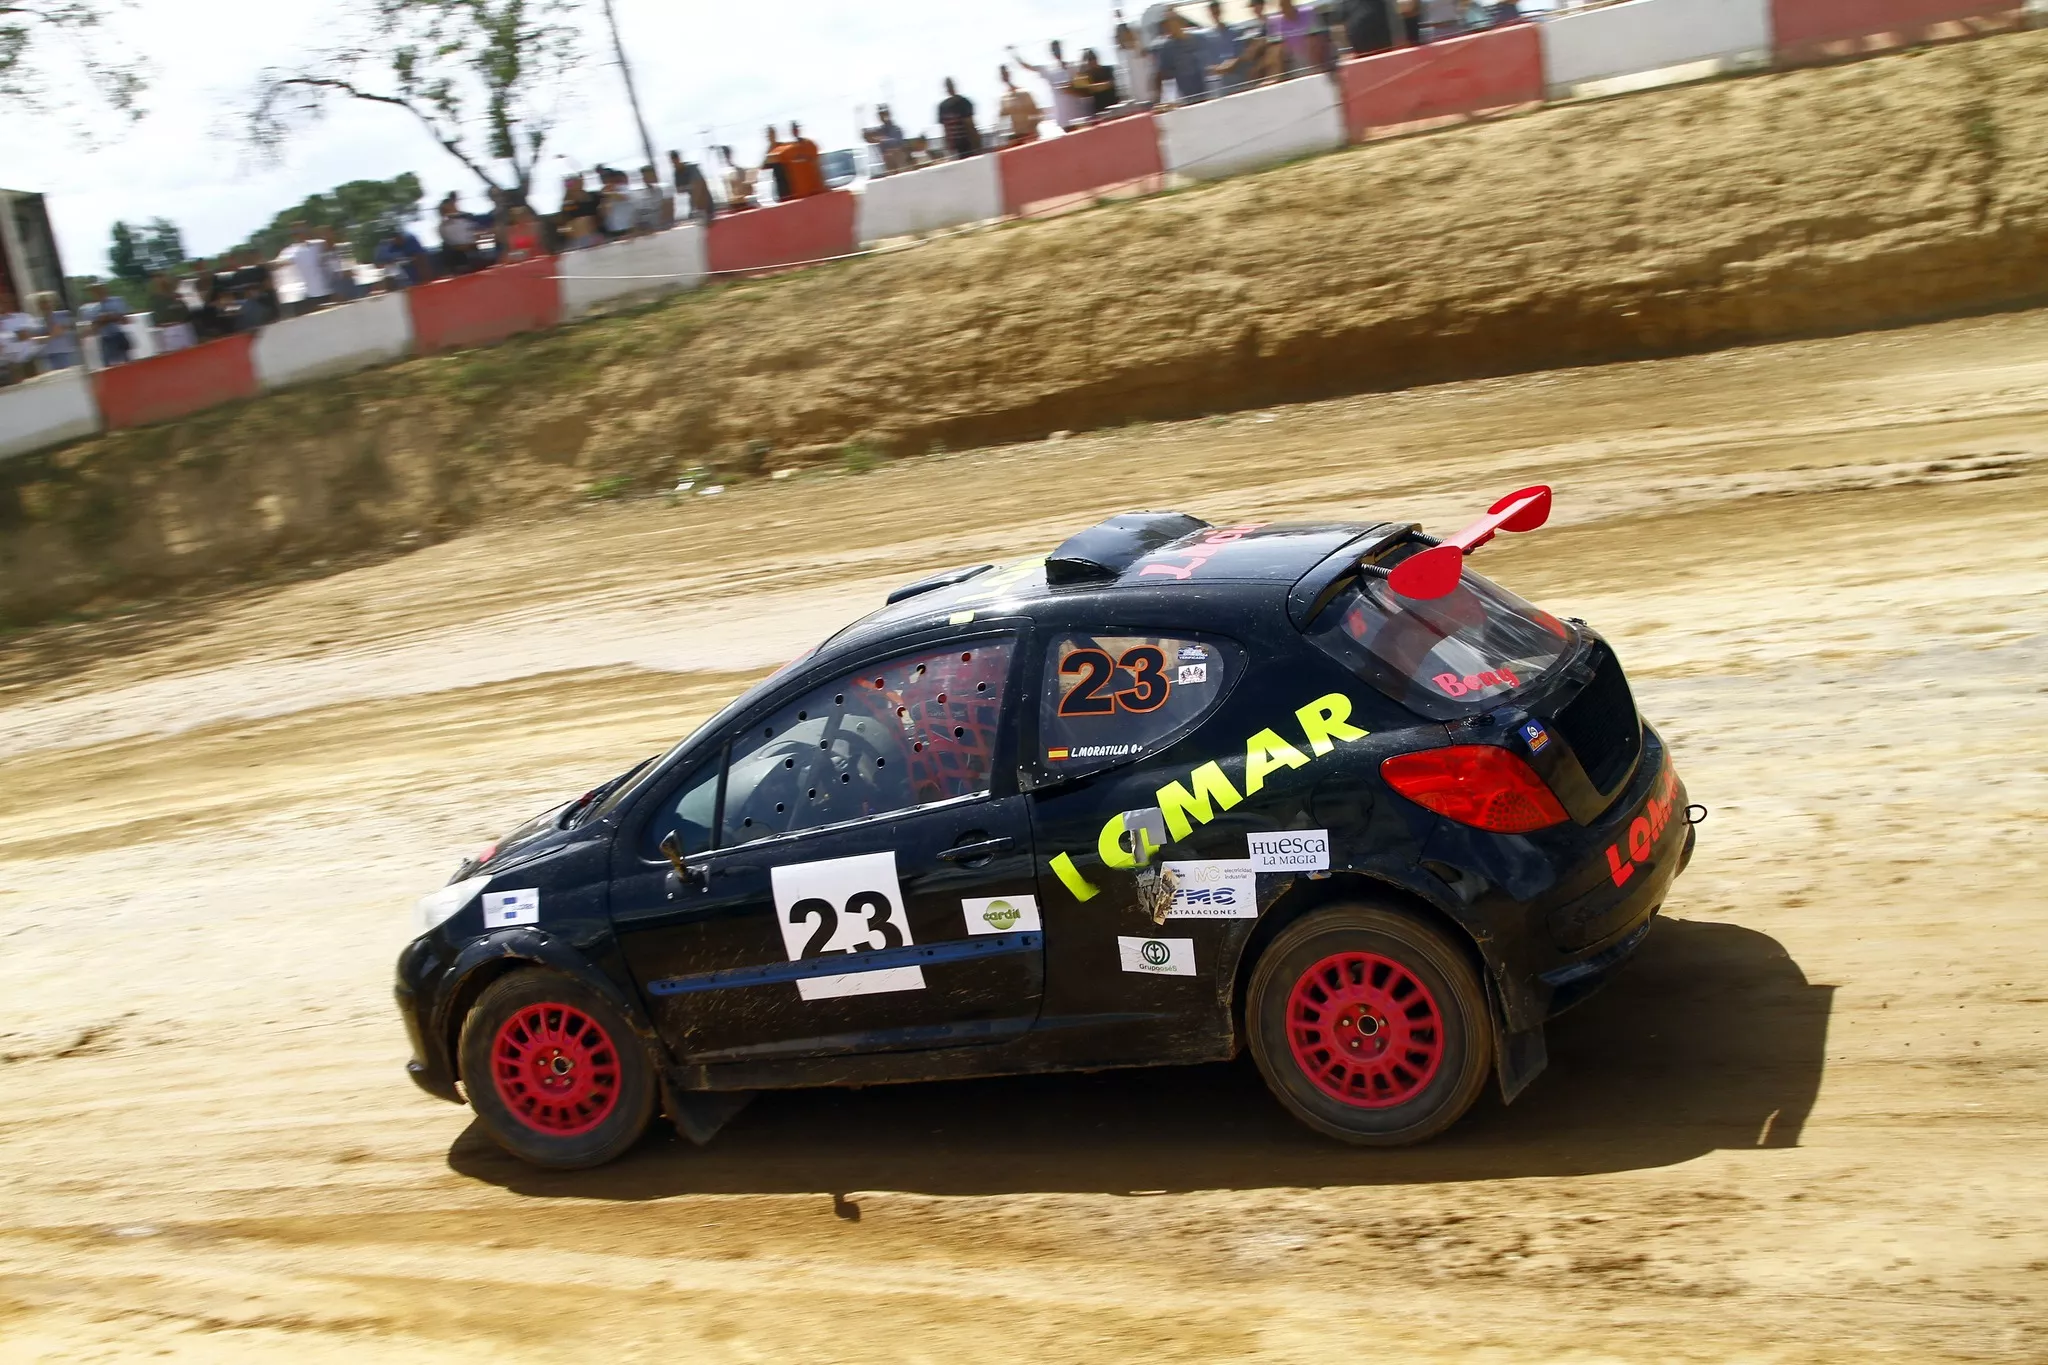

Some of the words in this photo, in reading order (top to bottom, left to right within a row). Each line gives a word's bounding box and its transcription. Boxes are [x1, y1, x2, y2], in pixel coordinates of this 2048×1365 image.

[1058, 644, 1172, 717] 23
[1071, 744, 1129, 758] L.MORATILLA
[789, 890, 904, 960] 23
